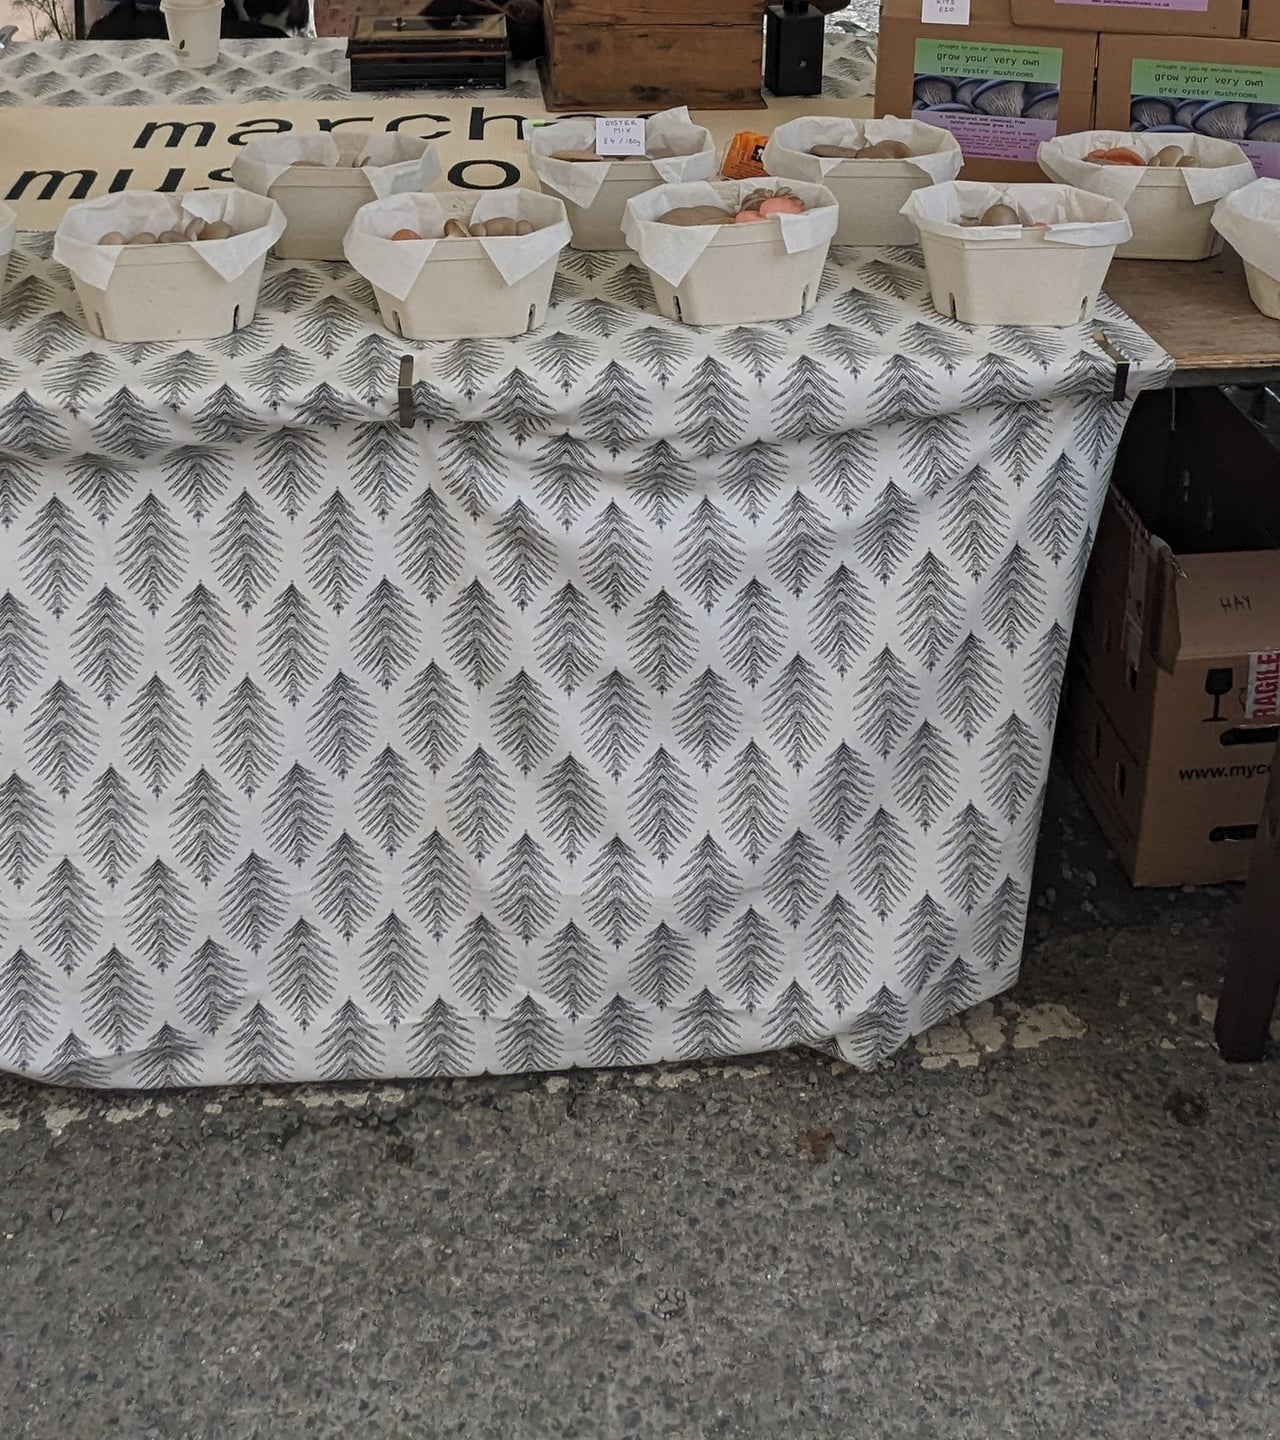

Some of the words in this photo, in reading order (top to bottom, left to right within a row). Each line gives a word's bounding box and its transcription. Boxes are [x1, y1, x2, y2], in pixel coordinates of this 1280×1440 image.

[937, 52, 960, 61] grow
[965, 55, 988, 63] your
[994, 57, 1017, 66] very
[941, 65, 958, 73] grey
[963, 67, 989, 75] oyster
[993, 70, 1034, 78] mushrooms
[1154, 73, 1178, 82] grow
[1184, 75, 1208, 83] your
[1215, 78, 1239, 86] very
[1214, 90, 1257, 98] mushrooms
[1221, 595, 1251, 611] HAY
[1253, 652, 1280, 718] RAGILE
